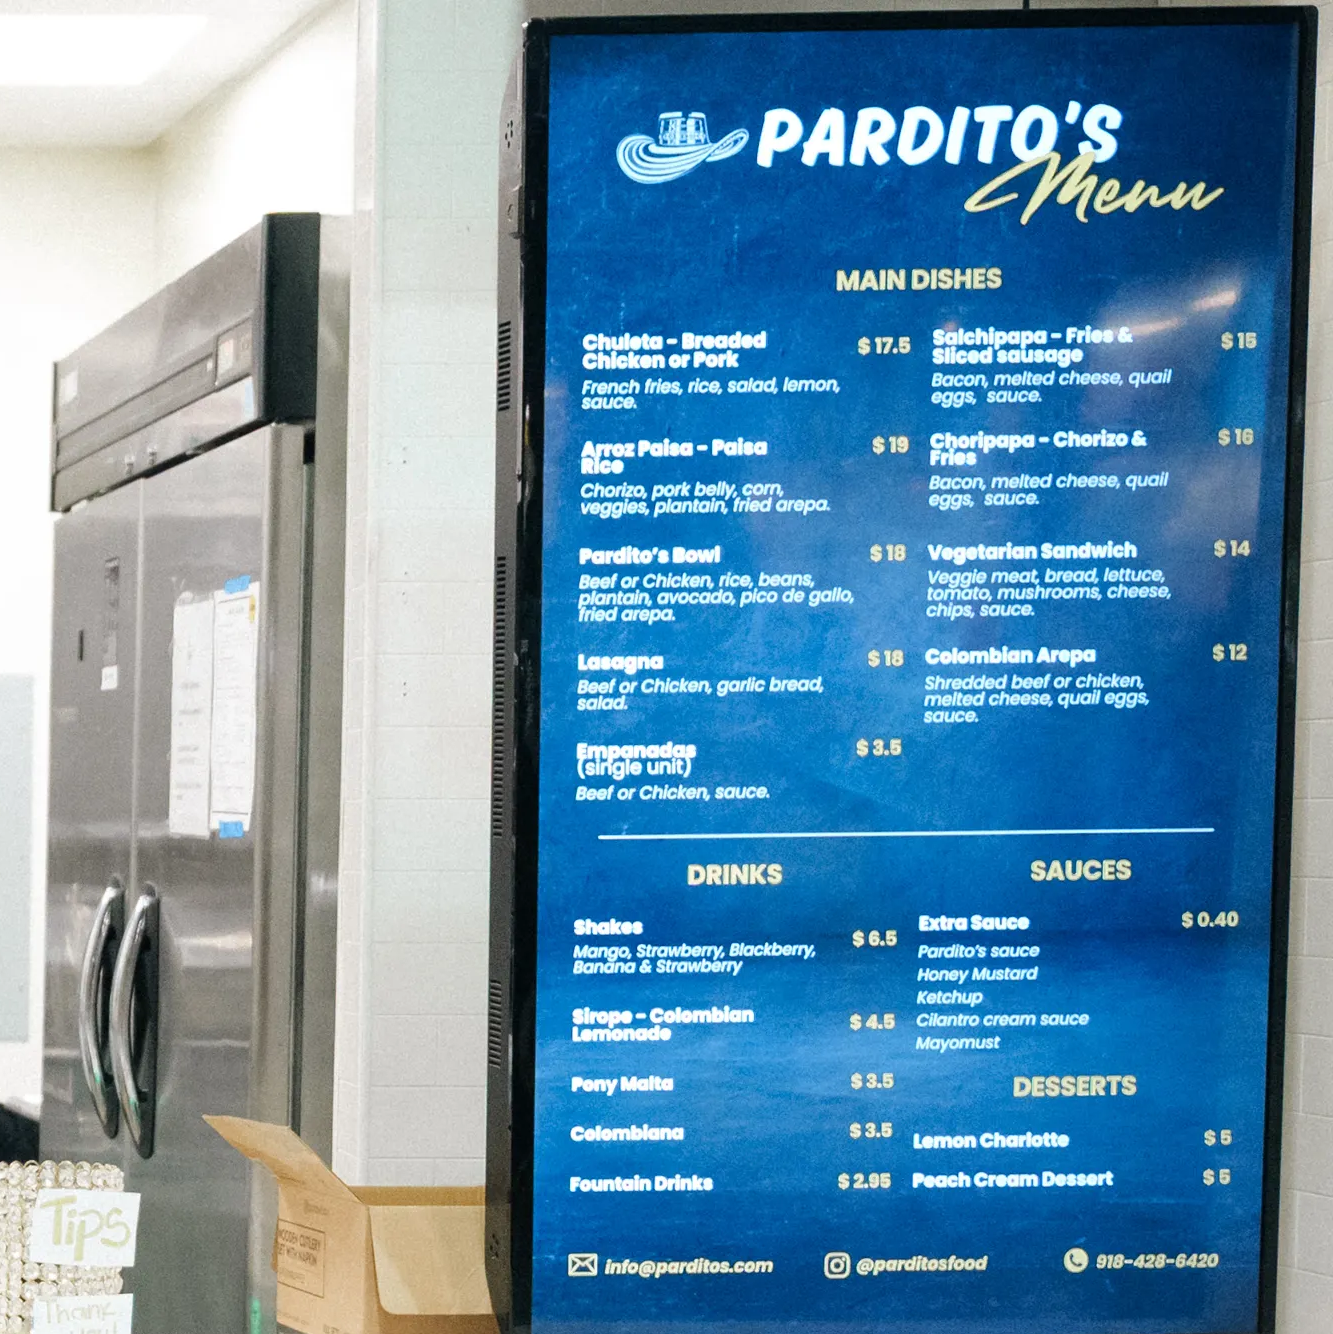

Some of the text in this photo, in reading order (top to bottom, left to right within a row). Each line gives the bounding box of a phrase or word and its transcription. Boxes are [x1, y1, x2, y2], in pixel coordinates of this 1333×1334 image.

[757, 101, 1123, 167] PARDITO'S
[964, 151, 1223, 226] Menu
[837, 268, 1002, 291] MAIN DISHES
[583, 331, 766, 352] Chuleta Breaded
[875, 337, 911, 354] 17.5
[933, 326, 1114, 349] Salchipapa Fries
[1238, 332, 1257, 349] 15
[583, 350, 738, 369] Chicken or Pork
[933, 347, 1083, 366] Sliced sausage
[582, 377, 840, 398] French fries, rice, salad, lemon,
[932, 370, 1171, 388] Bacon, melted cheese, quail
[582, 397, 637, 409] sauce.
[931, 390, 1042, 408] eggs, sauce.
[889, 436, 909, 453] 19
[930, 430, 1128, 454] Choripapa Chorizo
[1235, 428, 1254, 445] 16
[581, 438, 767, 459] Arroz Paisa Paisa
[581, 458, 624, 474] Rice
[930, 450, 976, 465] Fries
[673, 546, 720, 563] Bowl
[886, 544, 906, 561] 18
[928, 541, 1137, 565] Vegetarian Sandwich
[1231, 540, 1250, 556] 14
[579, 572, 814, 591] Beef or Chicken, rice, beans,
[929, 568, 1165, 588] Veggie meat, bread, lettuce,
[578, 587, 854, 609] plantain, avocado, pico de gallo,
[928, 584, 1171, 603] tomato, mushrooms, cheese,
[578, 607, 675, 625] fried arepa.
[926, 603, 1034, 621] chips, sauce.
[884, 650, 903, 666] 18
[925, 647, 1096, 667] Colombian Arepa
[1229, 644, 1247, 660] 12
[578, 654, 663, 675] Lasagna
[925, 674, 1144, 690] Shredded beef or chicken,
[924, 690, 1149, 709] melted cheese, quail eggs,
[924, 711, 978, 723] sauce.
[577, 741, 696, 761] Empanadas
[873, 739, 901, 756] 3.5
[577, 758, 691, 780] (single unit)
[688, 864, 782, 886] DRINKS
[1031, 860, 1131, 881] SAUCES
[574, 919, 643, 935] Shakes
[919, 915, 1029, 931] Extra Sauce
[1198, 911, 1239, 927] 0.40
[869, 930, 897, 946] 6.5
[573, 943, 815, 963] Mango, Strawberry, Blackberry,
[991, 946, 1040, 957] sauce
[573, 959, 743, 976] Banana Strawberry
[917, 966, 1038, 984] Honey Mustard
[917, 990, 983, 1007] Ketchup
[572, 1007, 754, 1030] Sirope Colombian
[866, 1014, 895, 1029] 4.5
[917, 1013, 1089, 1026] Cilantro cream sauce
[572, 1026, 671, 1042] Lemonade
[916, 1036, 1001, 1053] Mayomust
[572, 1076, 673, 1096] Pony Malta
[866, 1073, 894, 1088] 3.5
[1013, 1075, 1137, 1097] DESSERTS
[571, 1125, 684, 1141] Colombiana
[865, 1123, 892, 1138] 3.5
[1221, 1130, 1232, 1145] 5
[914, 1132, 1069, 1149] Lemon Charlotte
[570, 1175, 713, 1192] Fountain Drinks
[853, 1173, 891, 1189] 2.95
[913, 1171, 1113, 1188] Peach Cream Dessert
[1219, 1169, 1230, 1184] 5
[39, 1194, 131, 1262] Tips
[605, 1258, 773, 1278] info@parditos.com
[856, 1256, 988, 1274] @parditosfood
[1096, 1254, 1219, 1269] 918-428-6420
[38, 1298, 117, 1324] Thank
